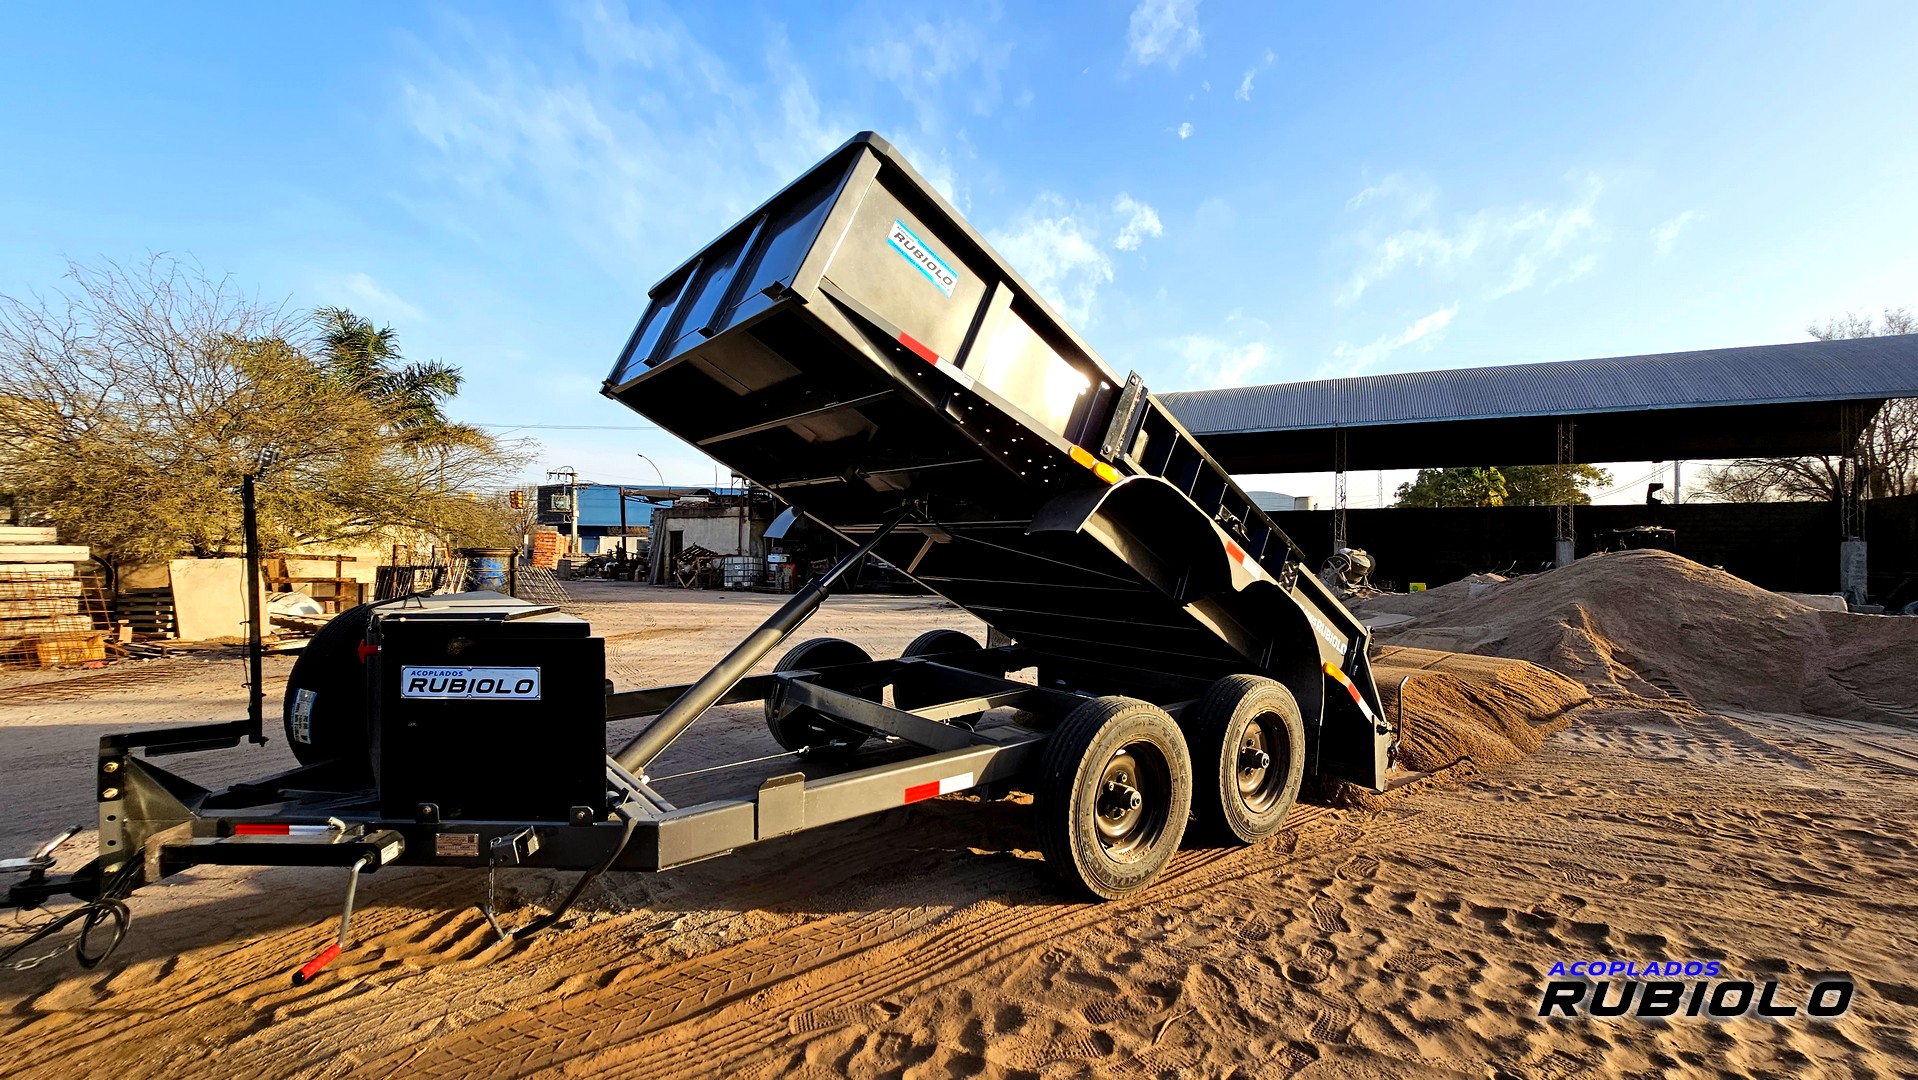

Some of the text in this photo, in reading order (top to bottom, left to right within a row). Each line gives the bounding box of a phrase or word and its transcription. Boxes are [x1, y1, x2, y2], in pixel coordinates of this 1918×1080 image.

[893, 232, 953, 286] RUBIOLO
[1316, 619, 1347, 656] RUBIOLO
[408, 678, 535, 694] RUBIOLO
